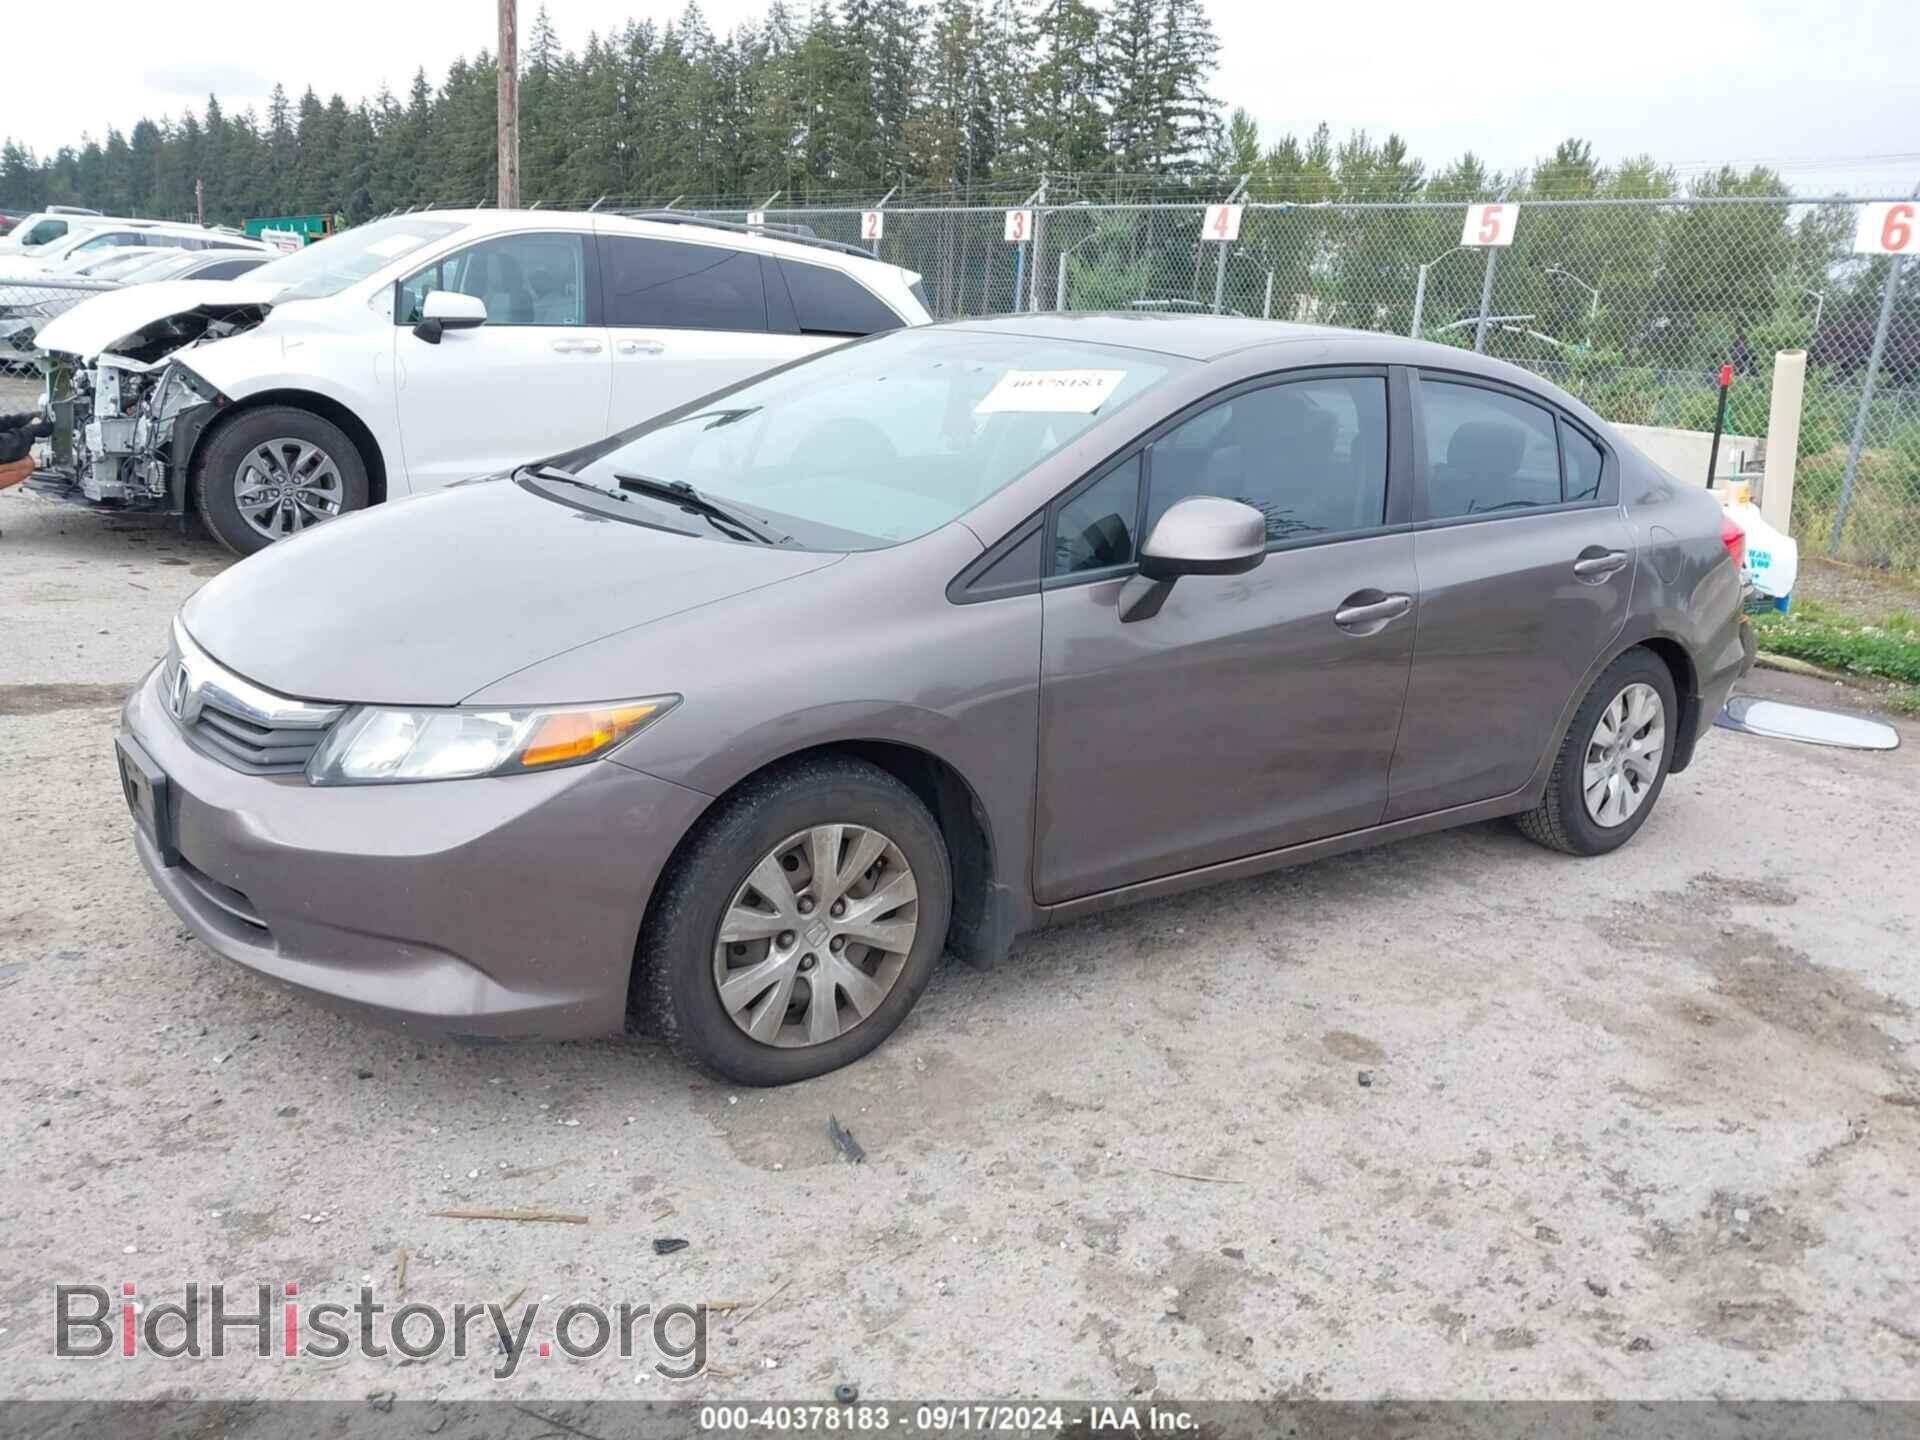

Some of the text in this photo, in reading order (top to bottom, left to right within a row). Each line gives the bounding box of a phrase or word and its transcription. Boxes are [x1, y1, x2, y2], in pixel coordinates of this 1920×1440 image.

[868, 213, 877, 237] 2
[1012, 212, 1024, 239] 3
[1214, 206, 1229, 237] 4
[1479, 205, 1504, 244] 5
[1881, 204, 1915, 251] 6
